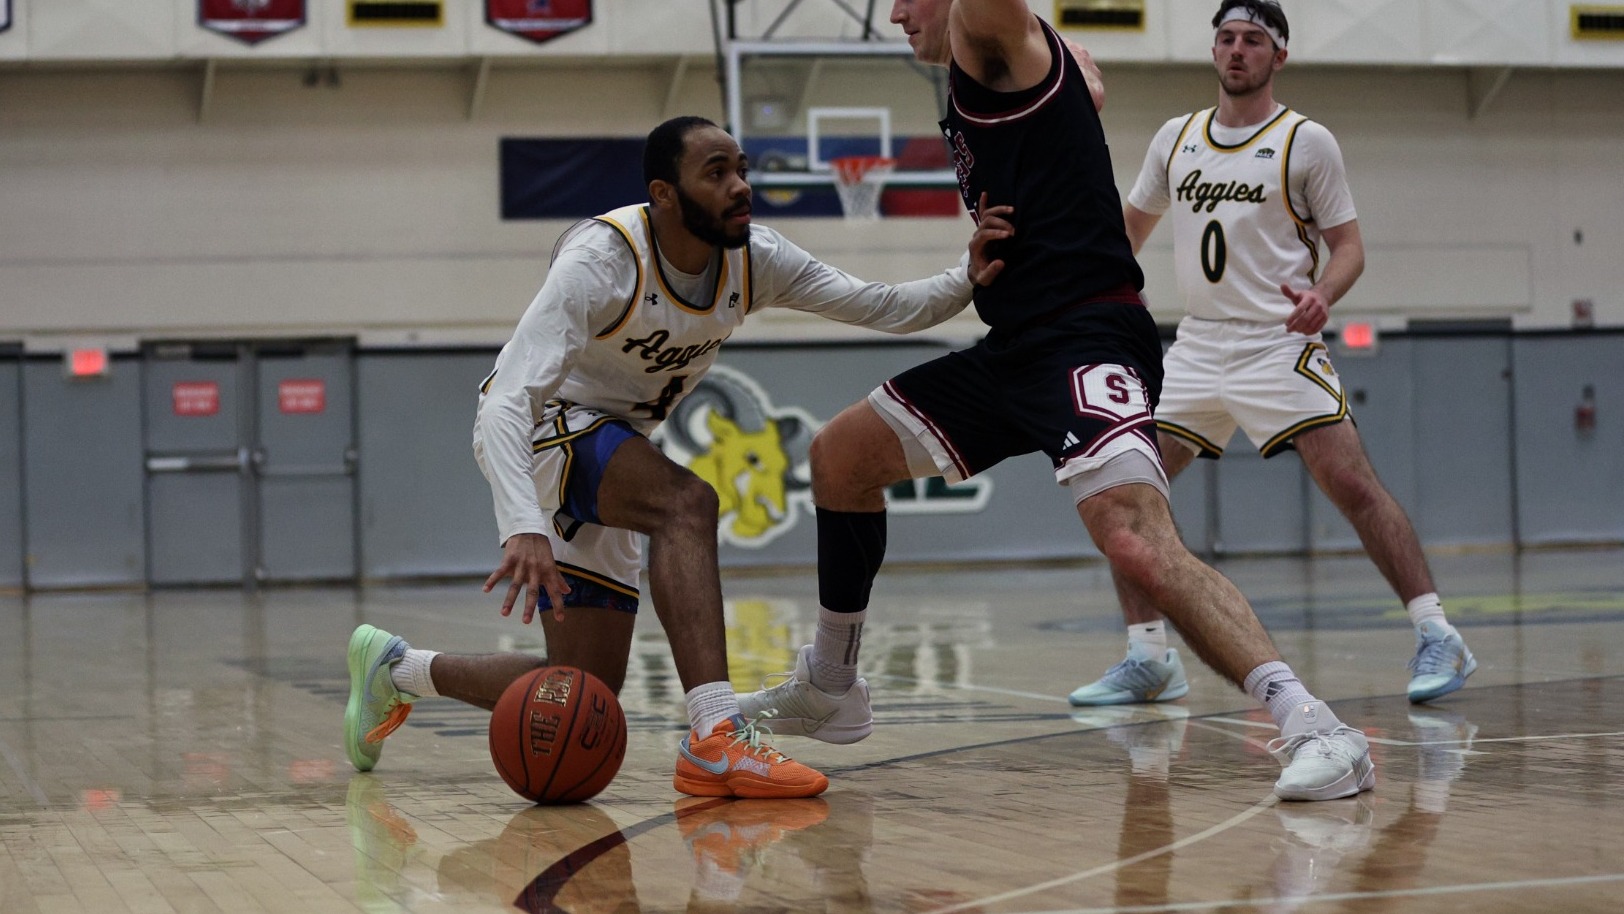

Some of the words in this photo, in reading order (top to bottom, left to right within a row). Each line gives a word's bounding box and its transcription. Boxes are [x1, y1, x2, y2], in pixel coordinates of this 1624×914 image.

[1176, 169, 1267, 213] Aggies
[1201, 219, 1226, 283] 0
[621, 329, 723, 374] Aggie
[1105, 374, 1130, 404] S
[530, 710, 561, 756] THE
